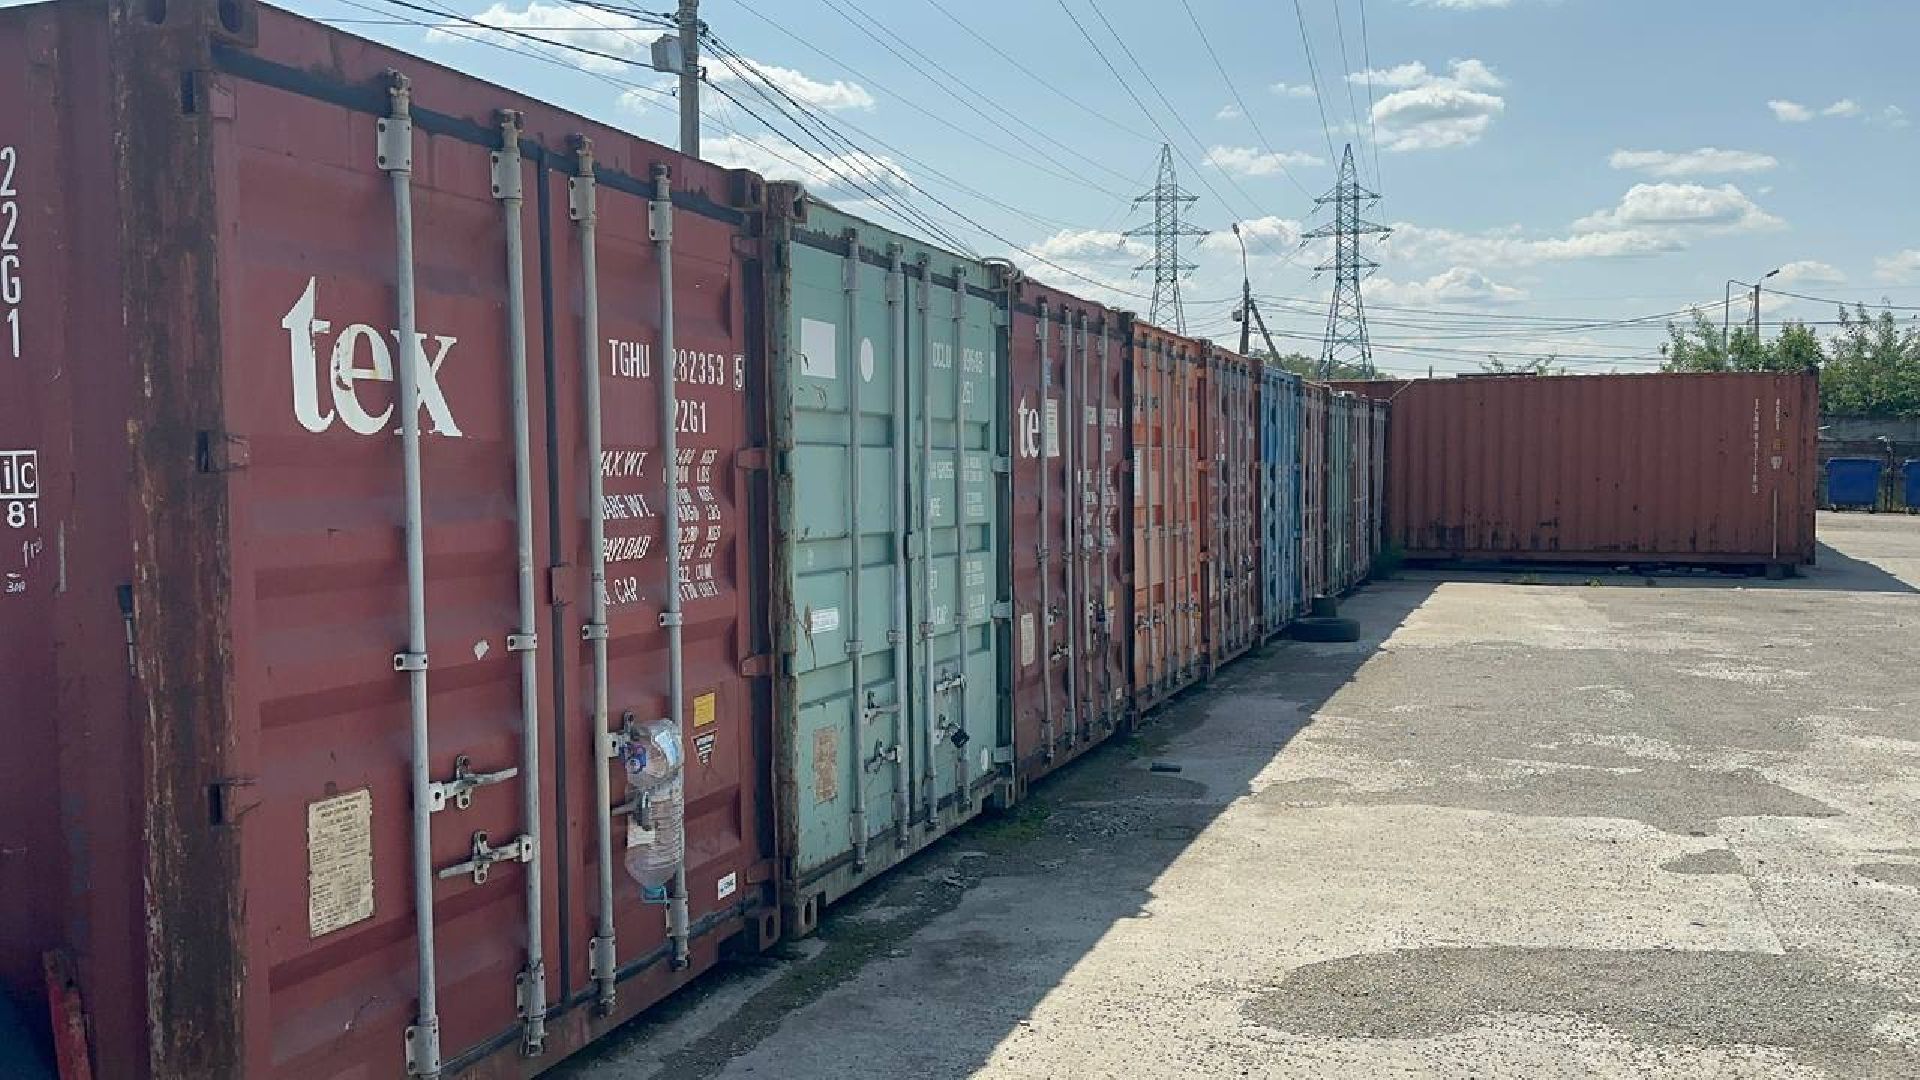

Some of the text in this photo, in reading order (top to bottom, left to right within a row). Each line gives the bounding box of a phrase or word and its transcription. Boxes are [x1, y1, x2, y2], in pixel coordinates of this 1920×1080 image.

[0, 146, 21, 358] 22G1
[281, 276, 463, 437] tex
[608, 339, 650, 378] TGHU
[1018, 398, 1040, 457] te
[7, 501, 38, 529] 81
